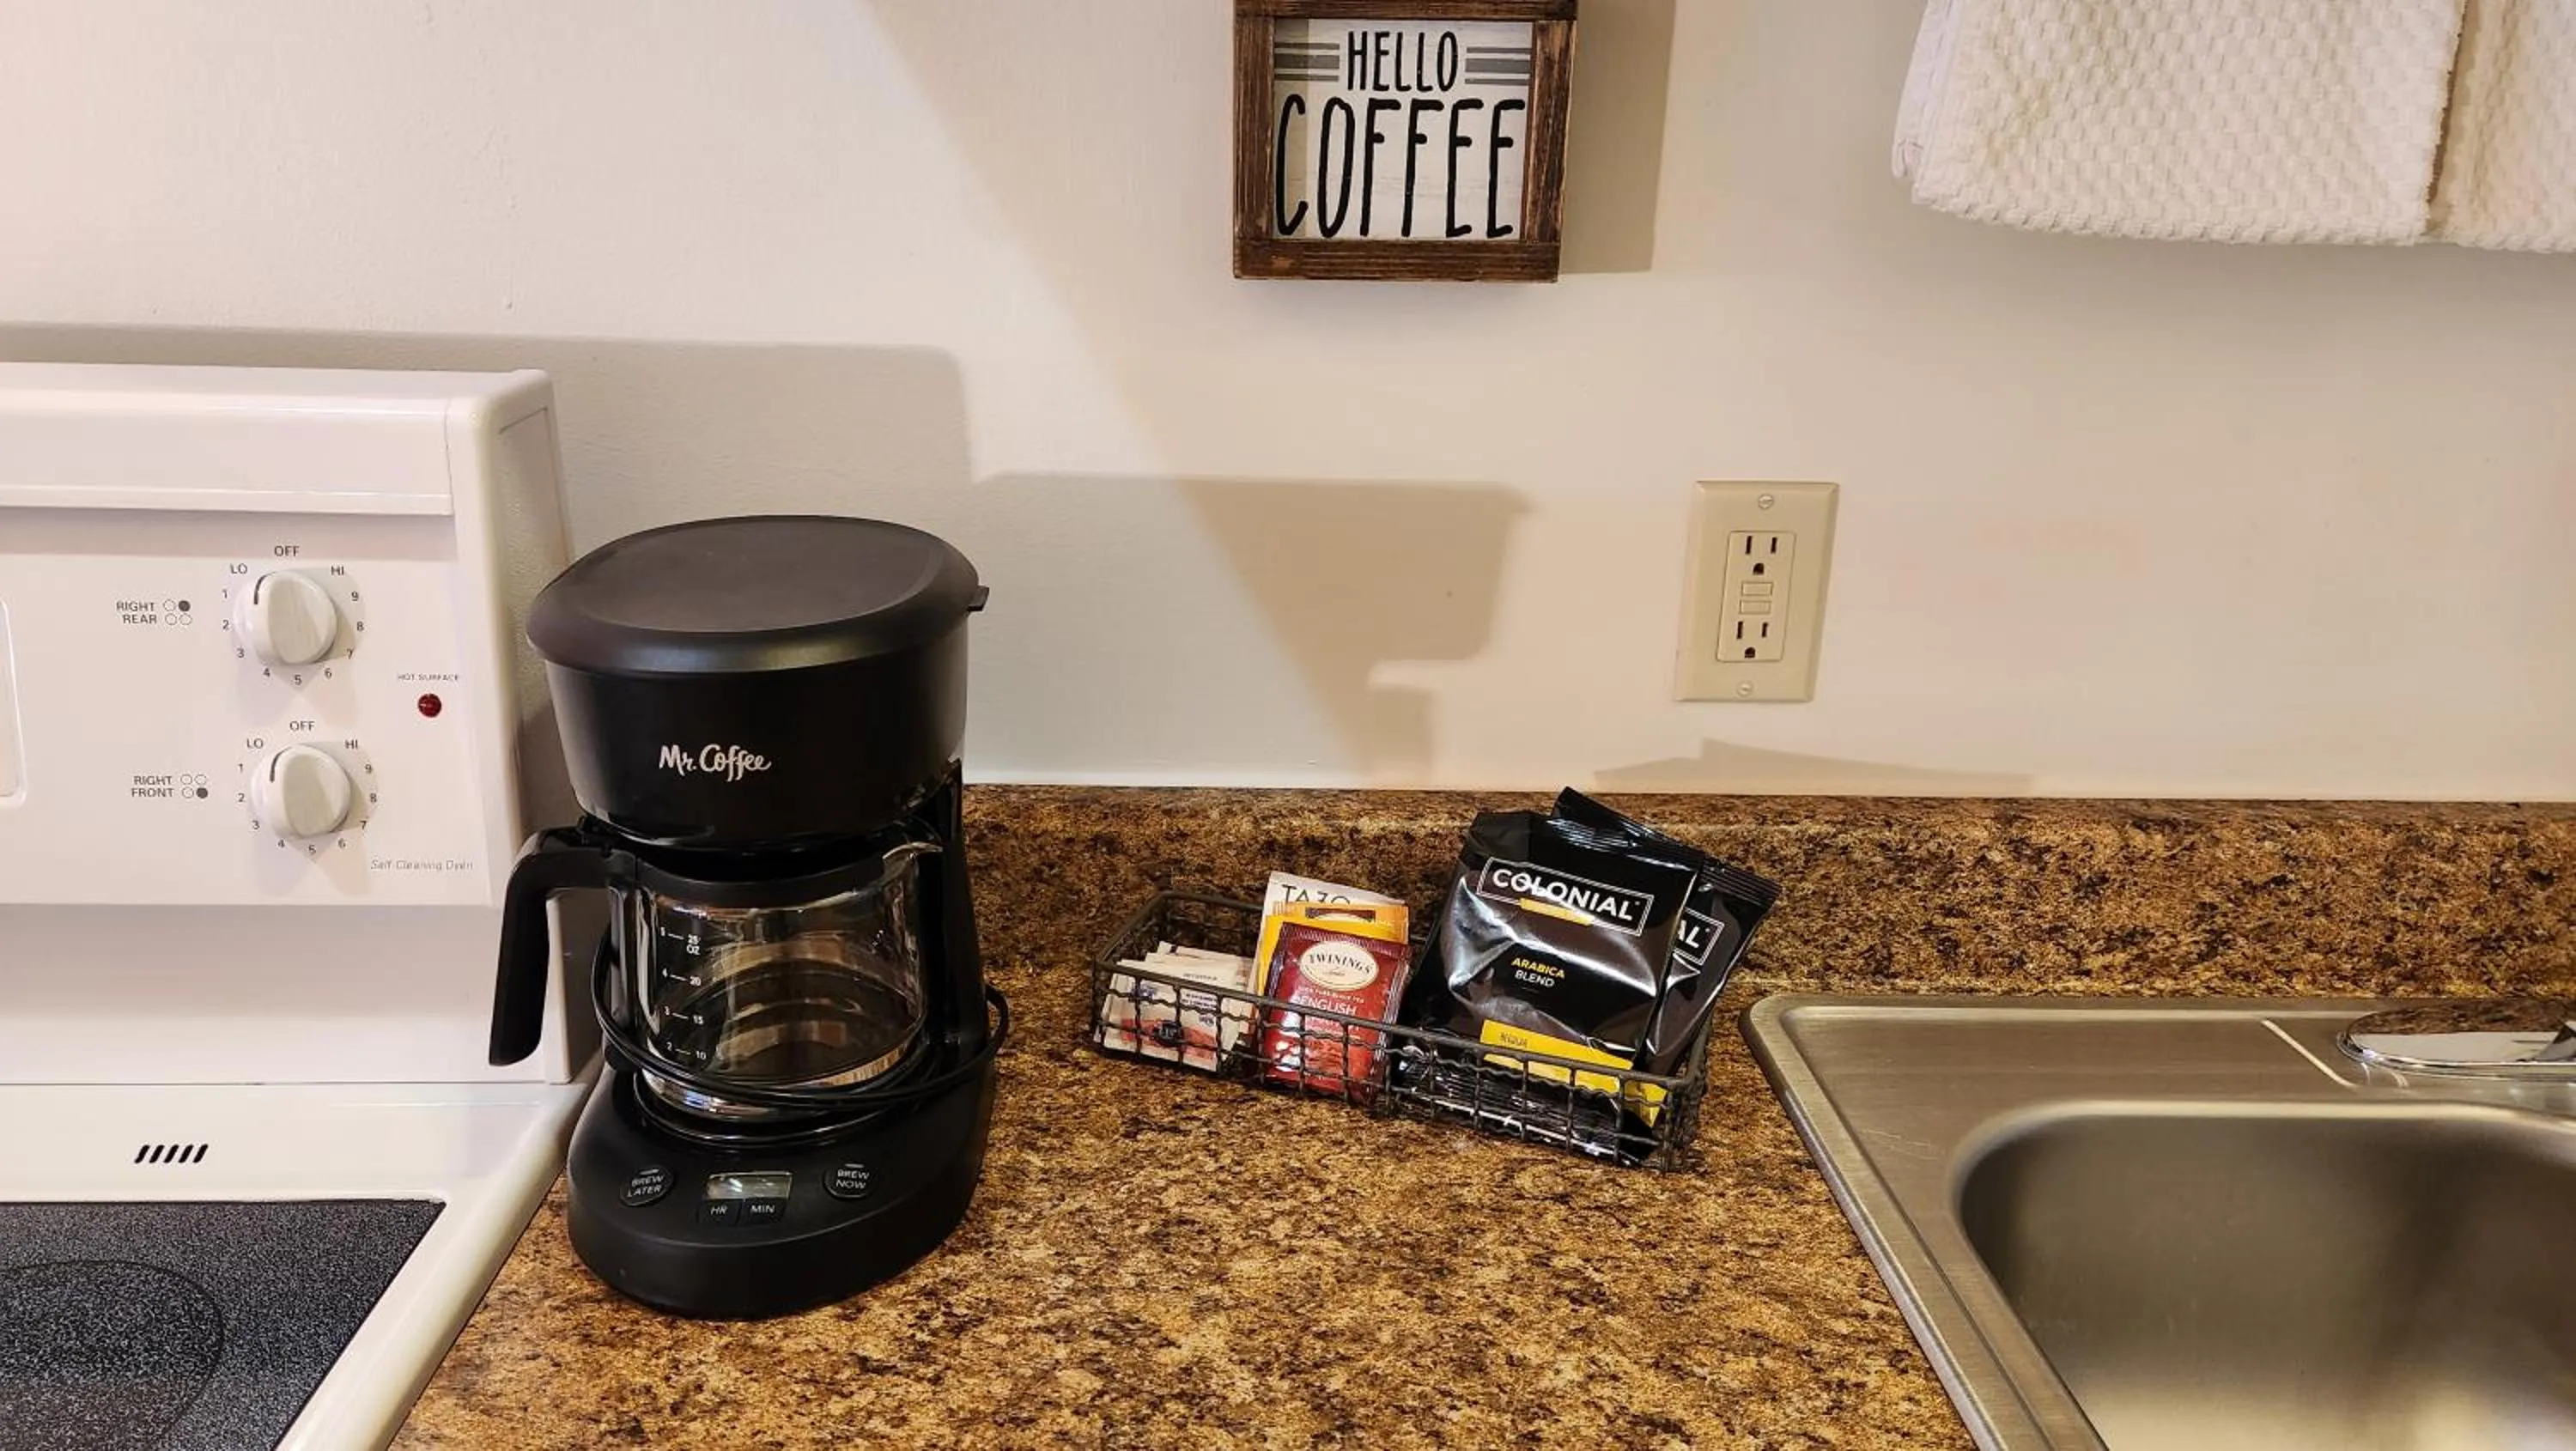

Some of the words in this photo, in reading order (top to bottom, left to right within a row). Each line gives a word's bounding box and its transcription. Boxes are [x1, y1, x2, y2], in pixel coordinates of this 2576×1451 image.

[1347, 31, 1458, 92] HELLO
[1275, 94, 1526, 239] COFFEE
[274, 545, 300, 558] OFF
[230, 563, 248, 575] LO
[331, 565, 345, 577] HI
[350, 591, 360, 602] 9
[116, 601, 155, 612] RIGHT
[122, 613, 157, 625] REAR
[222, 619, 230, 630] 2
[355, 621, 364, 633] 8
[236, 647, 245, 659] 3
[346, 647, 355, 659] 7
[262, 668, 270, 679] 4
[324, 668, 332, 679] 6
[293, 675, 302, 686] 5
[289, 721, 315, 732] OFF
[246, 738, 264, 750] LO
[345, 739, 359, 750] HI
[364, 763, 373, 774] 9
[659, 744, 697, 776] Mr.
[699, 744, 772, 782] Coffee
[133, 775, 173, 786] RIGHT
[131, 787, 174, 798] FRONT
[237, 792, 246, 803] 2
[369, 792, 378, 804] 8
[252, 821, 260, 830] 3
[360, 821, 368, 830] 7
[276, 839, 285, 848] 4
[337, 839, 346, 848] 6
[308, 844, 317, 855] 5
[1492, 868, 1633, 921] COLONIAL
[1308, 952, 1374, 974] TWININGS
[1511, 957, 1565, 979] ARABICA
[690, 975, 702, 987] 20
[1515, 969, 1555, 987] BLEND
[1298, 995, 1358, 1015] ENGLISH
[693, 1014, 704, 1025] 15
[666, 1041, 672, 1052] 2
[696, 1050, 707, 1060] 10
[837, 1169, 870, 1180] BREW
[631, 1174, 664, 1187] BREW
[835, 1179, 867, 1190] NOW
[627, 1184, 663, 1198] LATER
[710, 1205, 728, 1216] HR
[750, 1205, 775, 1215] MIN
